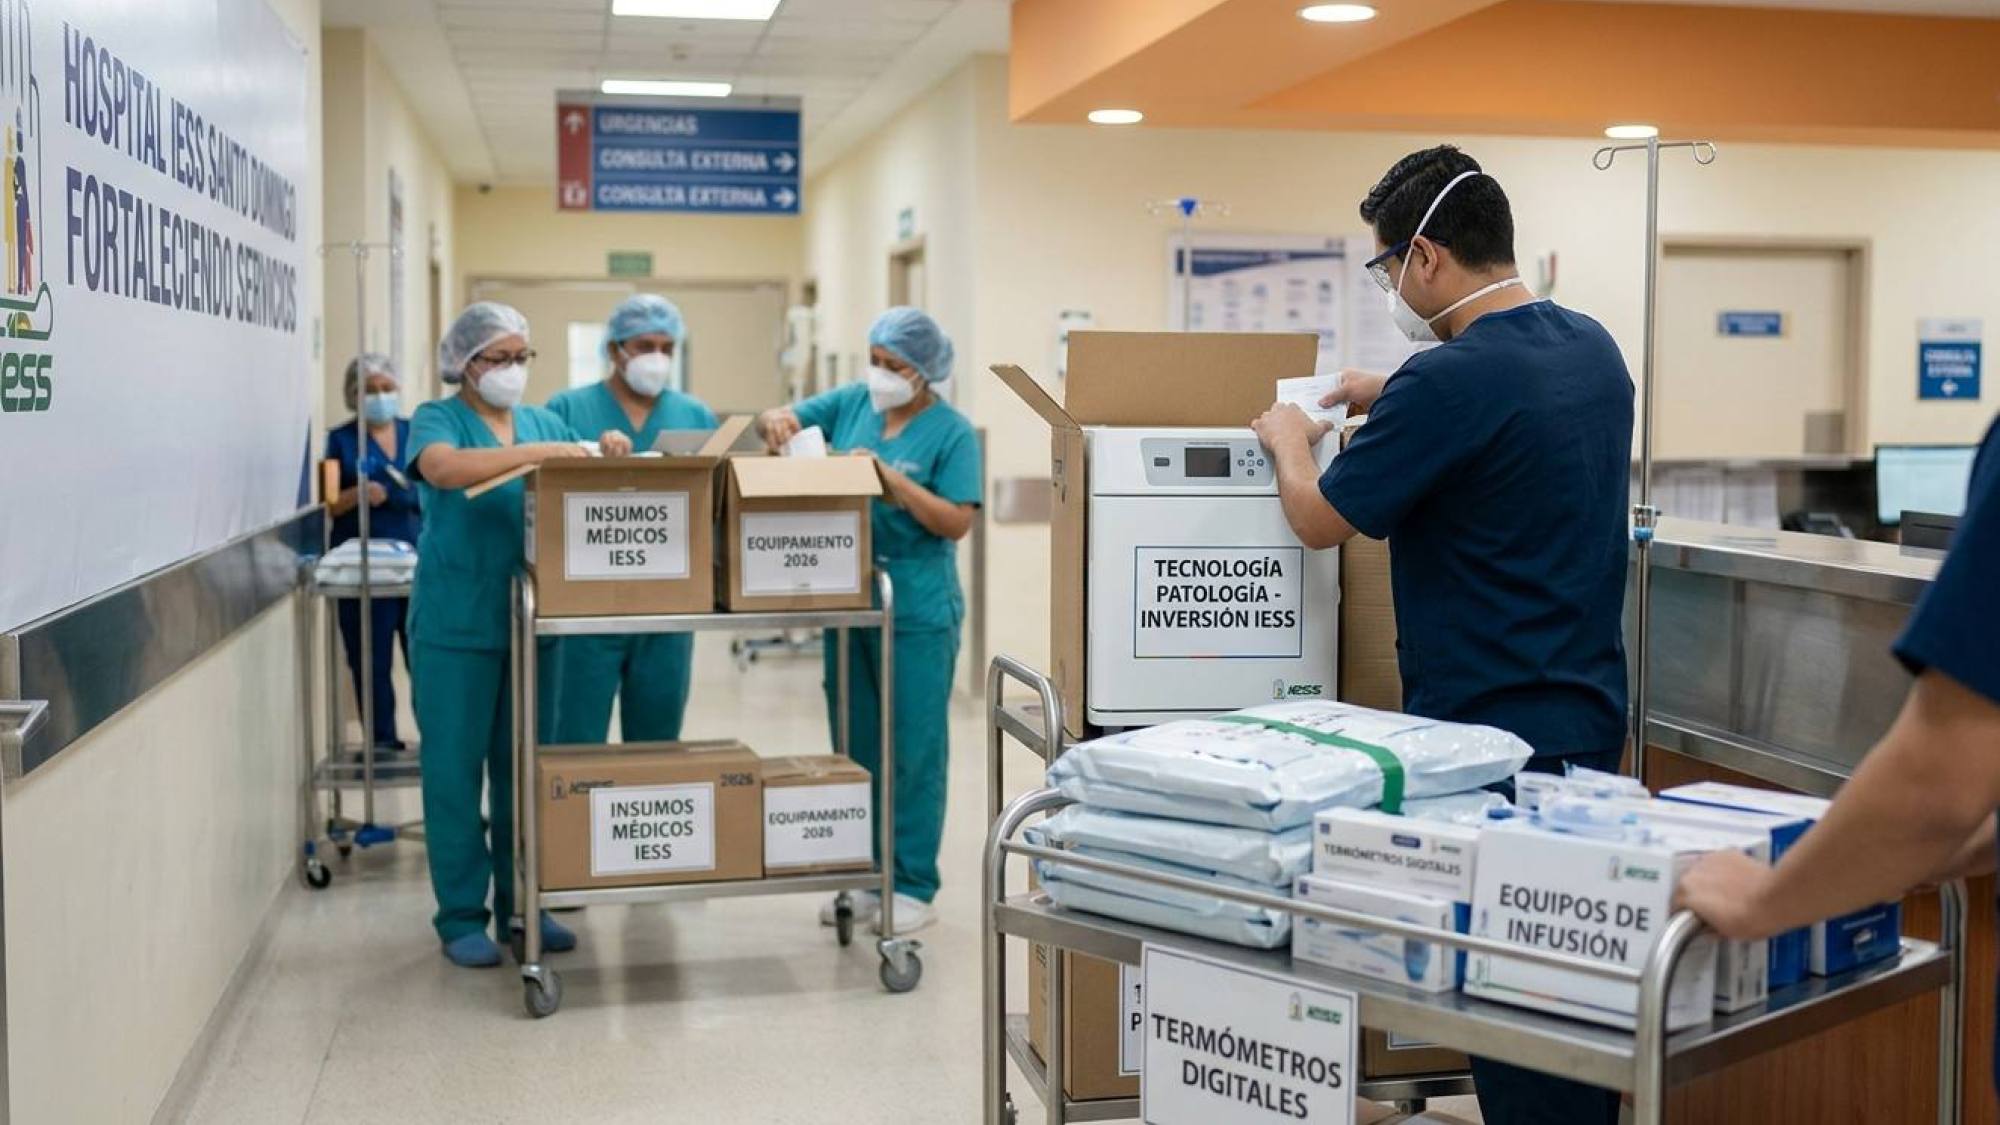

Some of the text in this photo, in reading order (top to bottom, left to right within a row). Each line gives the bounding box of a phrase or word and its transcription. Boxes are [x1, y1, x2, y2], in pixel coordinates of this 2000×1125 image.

[63, 21, 167, 174] HOSPITAL
[171, 97, 206, 194] IESS
[208, 123, 248, 217] SANTO
[600, 114, 698, 135] URGENCIAS
[601, 149, 769, 171] CONSULTA EXTERNA
[600, 184, 768, 207] CONSULTA EXTERNA
[66, 166, 232, 321] FORTALECIENDO
[584, 505, 668, 522] INSUMOS
[586, 525, 668, 545] MÉDICOS
[747, 535, 854, 551] EQUIPAMIENTO
[609, 550, 646, 566] IESS
[783, 554, 819, 568] 2026
[1154, 557, 1283, 578] TECNOLOGÍA
[1156, 582, 1269, 603] PATOLOGÍA
[1141, 608, 1296, 629] INVERSIÓN IESS
[611, 799, 694, 819] INSUMOS
[612, 820, 694, 840] MÉDICOS
[635, 844, 672, 860] IESS
[1500, 884, 1650, 932] EQUIPOS DE
[1507, 917, 1628, 961] INFUSIÓN
[1151, 1013, 1341, 1089] TERMÓMETROS
[1182, 1060, 1308, 1119] DIGITALES
